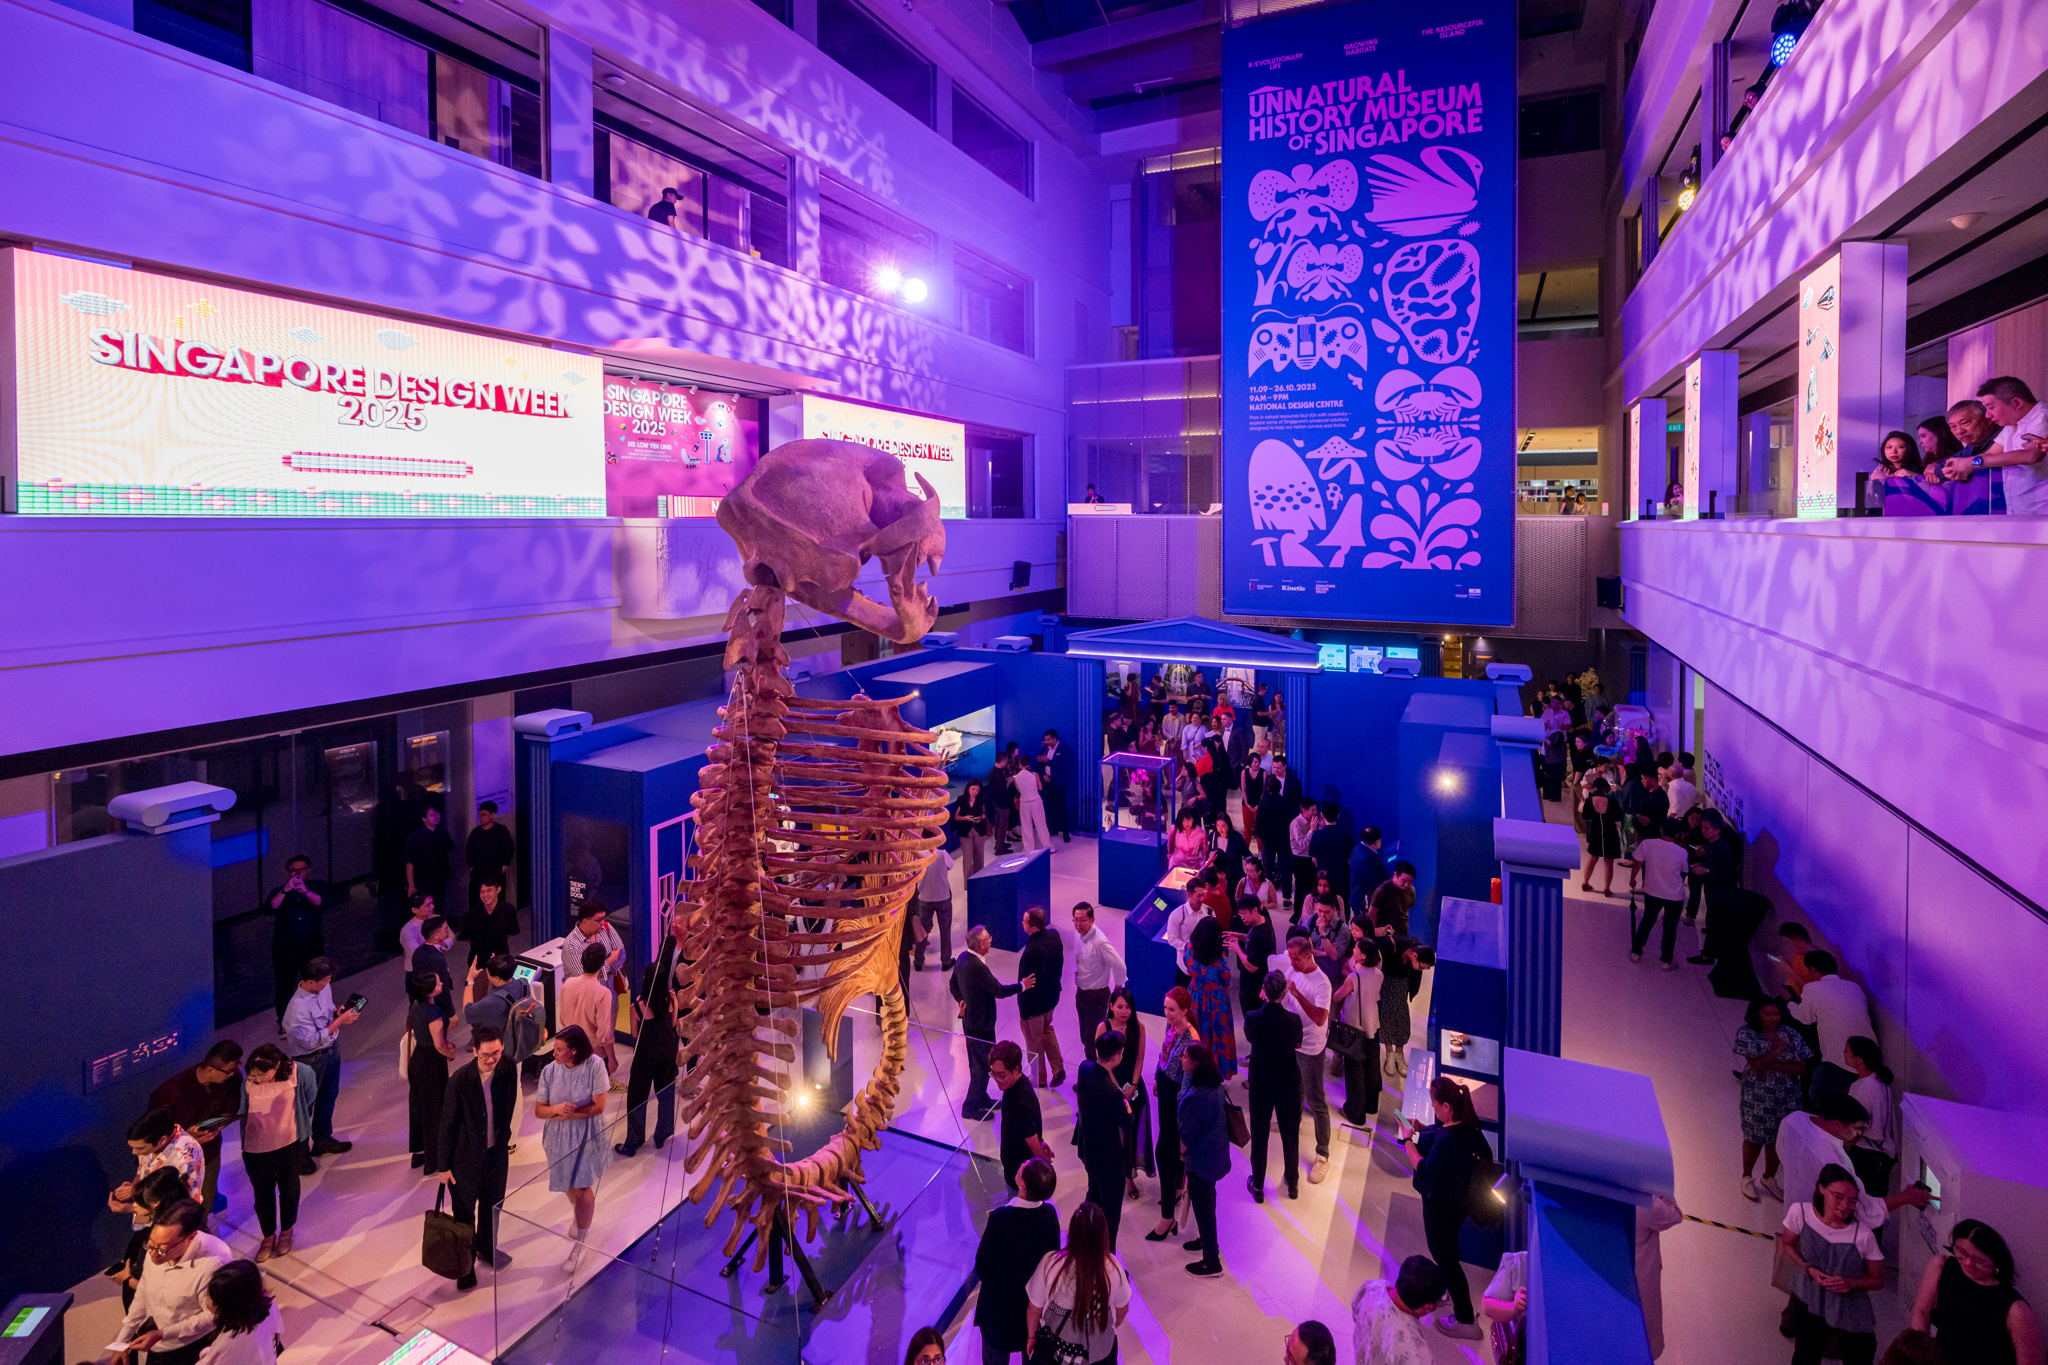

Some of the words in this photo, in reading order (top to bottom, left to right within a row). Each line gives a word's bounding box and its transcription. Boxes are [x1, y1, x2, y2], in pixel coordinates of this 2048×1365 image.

[1344, 39, 1378, 50] GROWING
[1421, 28, 1433, 36] THE
[1439, 29, 1466, 39] ISLAND
[1248, 69, 1412, 118] UNNATURAL
[1249, 102, 1358, 142] HISTORY
[1363, 82, 1483, 124] MUSEUM
[1288, 134, 1313, 151] OF
[1315, 107, 1483, 155] SINGAPORE
[89, 326, 367, 397] SINGAPORE
[373, 365, 497, 410] DESIGN
[500, 384, 575, 418] WEEK
[606, 384, 688, 410] SINGAPORE
[1249, 403, 1287, 411] NATIONAL
[1288, 401, 1314, 410] DESIGN
[1315, 400, 1344, 408] CENTRE
[337, 395, 428, 432] 2025
[604, 400, 654, 420] DESIGN
[657, 406, 692, 425] WEEK
[632, 419, 667, 436] 2025
